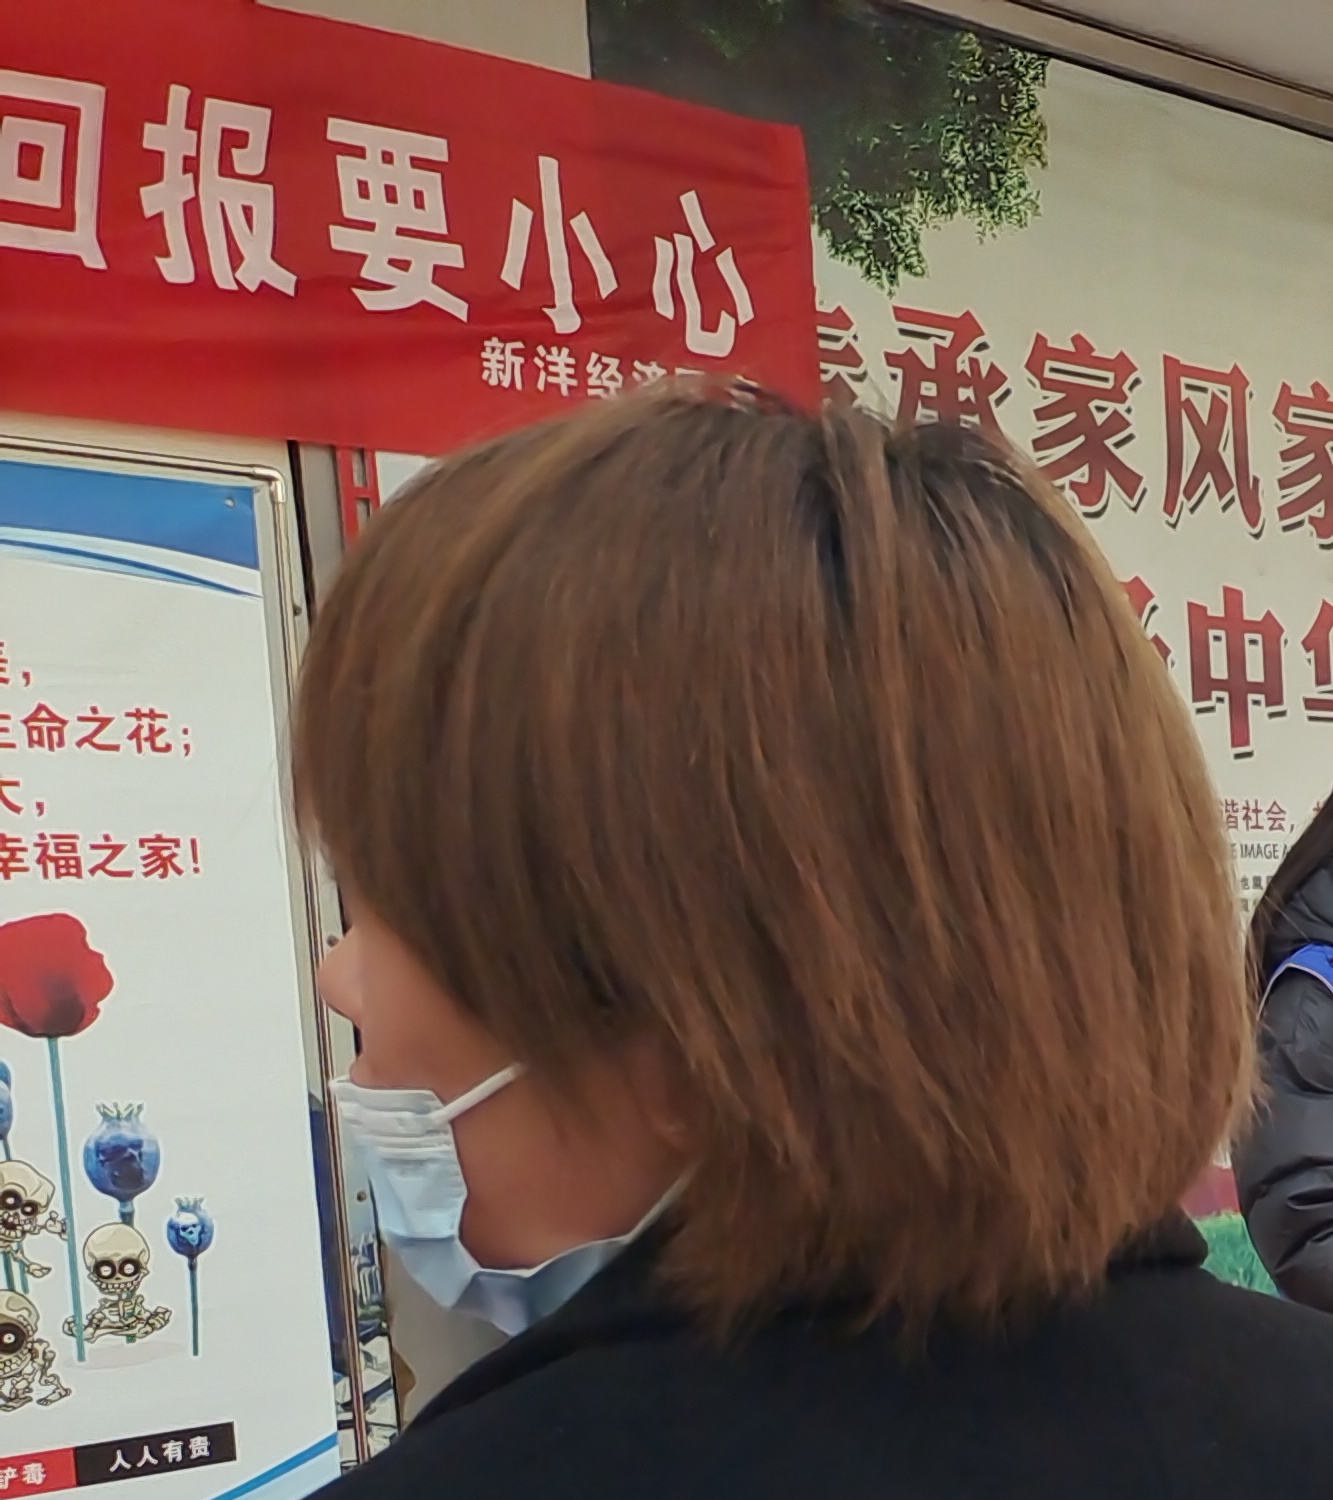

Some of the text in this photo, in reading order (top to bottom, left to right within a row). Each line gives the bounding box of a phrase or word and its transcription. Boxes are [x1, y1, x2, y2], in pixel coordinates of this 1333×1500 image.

[0, 69, 755, 359] 回报要小心
